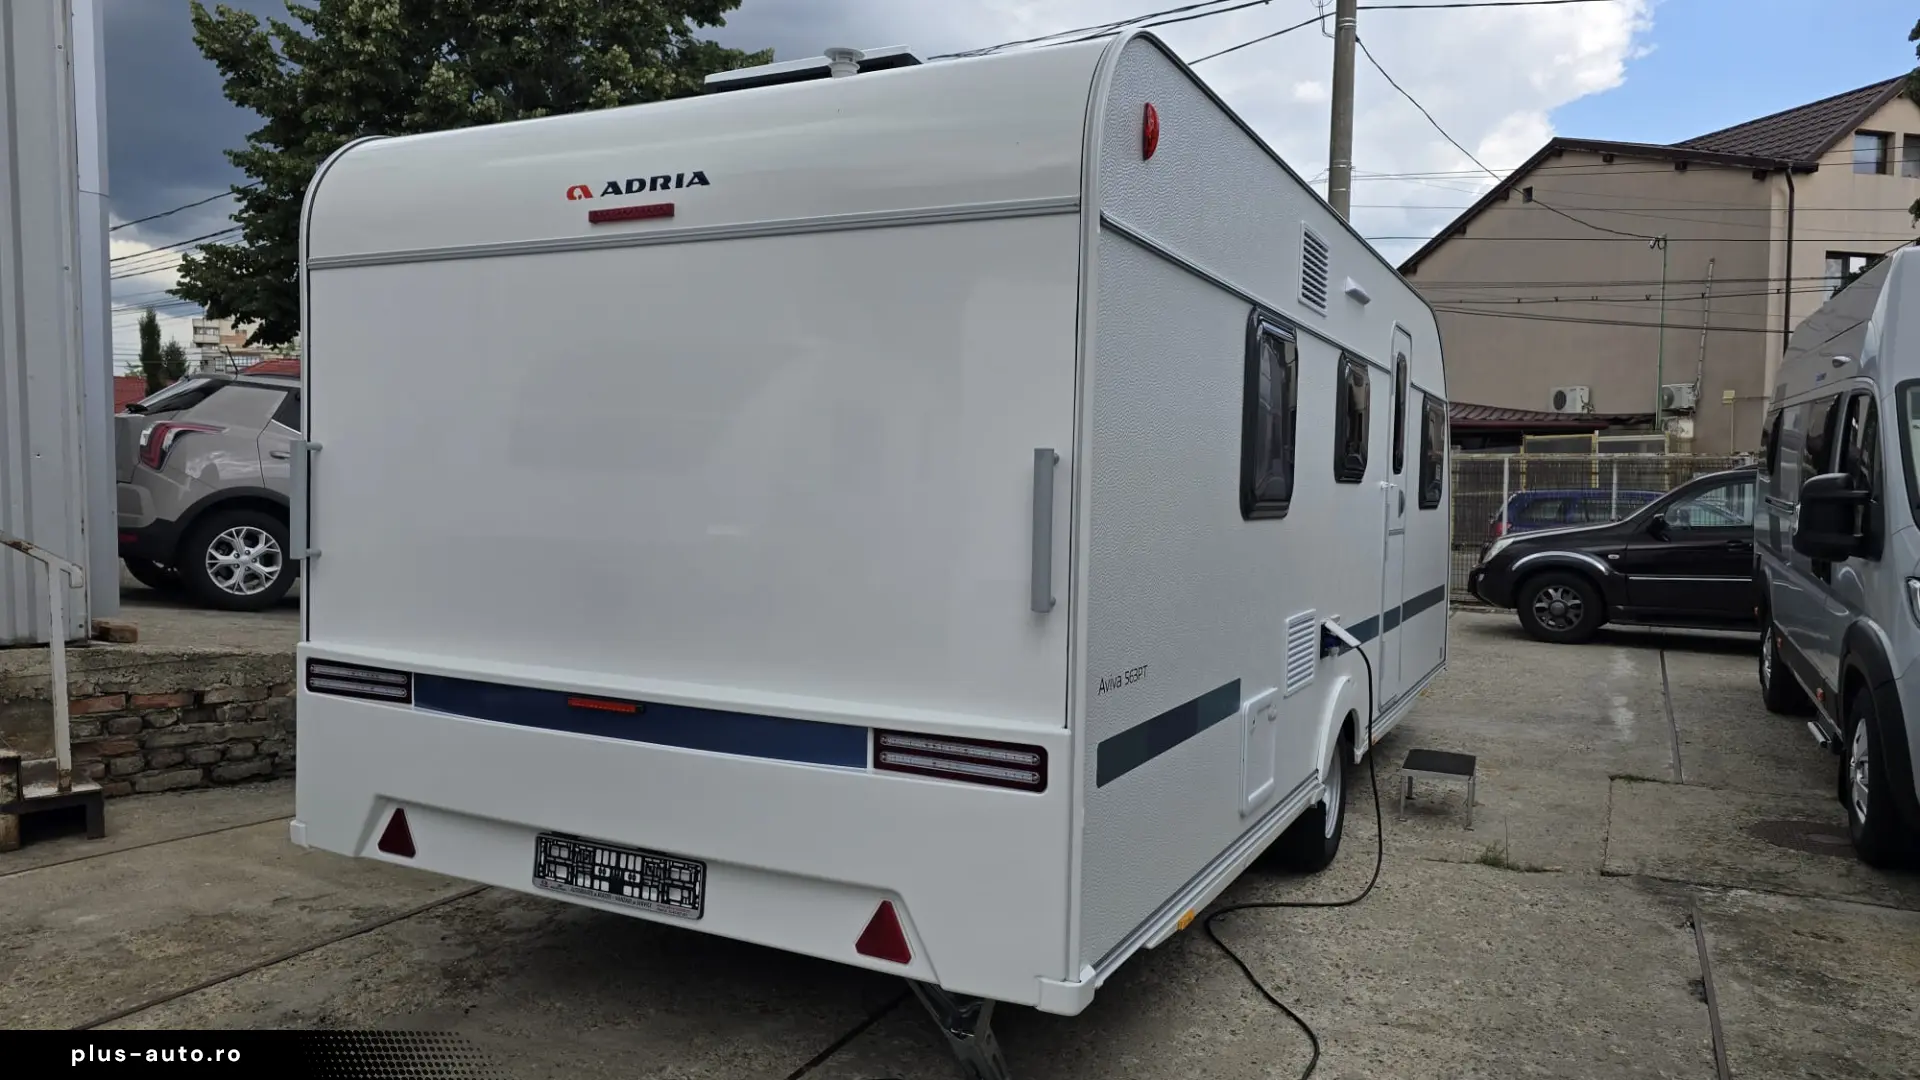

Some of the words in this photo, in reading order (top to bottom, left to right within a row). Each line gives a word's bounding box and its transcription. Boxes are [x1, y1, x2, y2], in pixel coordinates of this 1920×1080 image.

[600, 170, 711, 197] ADRIA
[1098, 674, 1122, 695] Aviva
[1124, 664, 1148, 686] 563PT
